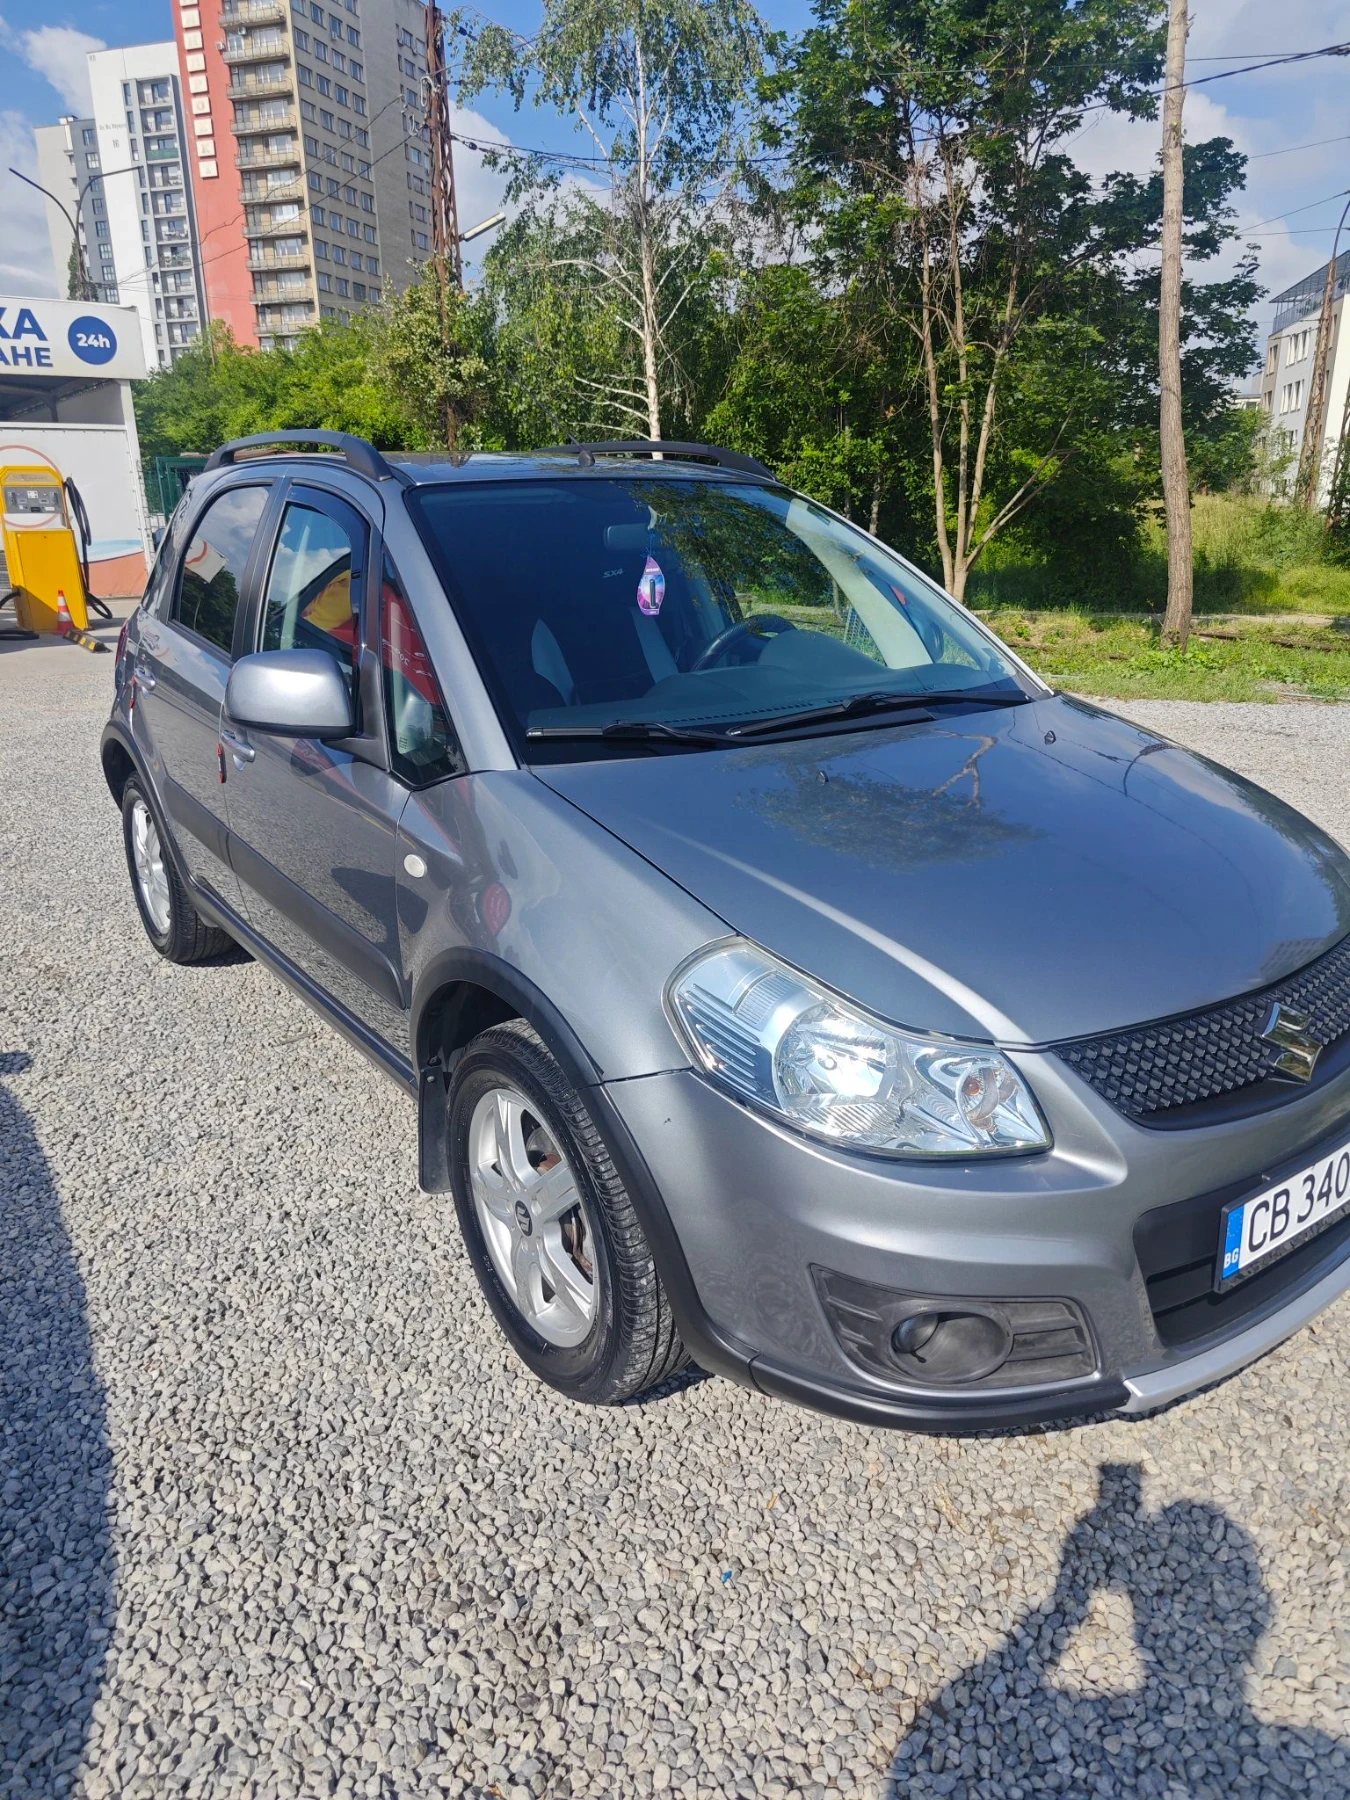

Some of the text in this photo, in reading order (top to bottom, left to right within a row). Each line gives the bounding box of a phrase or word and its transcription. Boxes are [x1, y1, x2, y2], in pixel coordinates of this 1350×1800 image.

[75, 333, 111, 349] 24h
[602, 567, 625, 579] SX4
[1248, 1151, 1350, 1253] CB 340
[1223, 1247, 1240, 1270] BG
